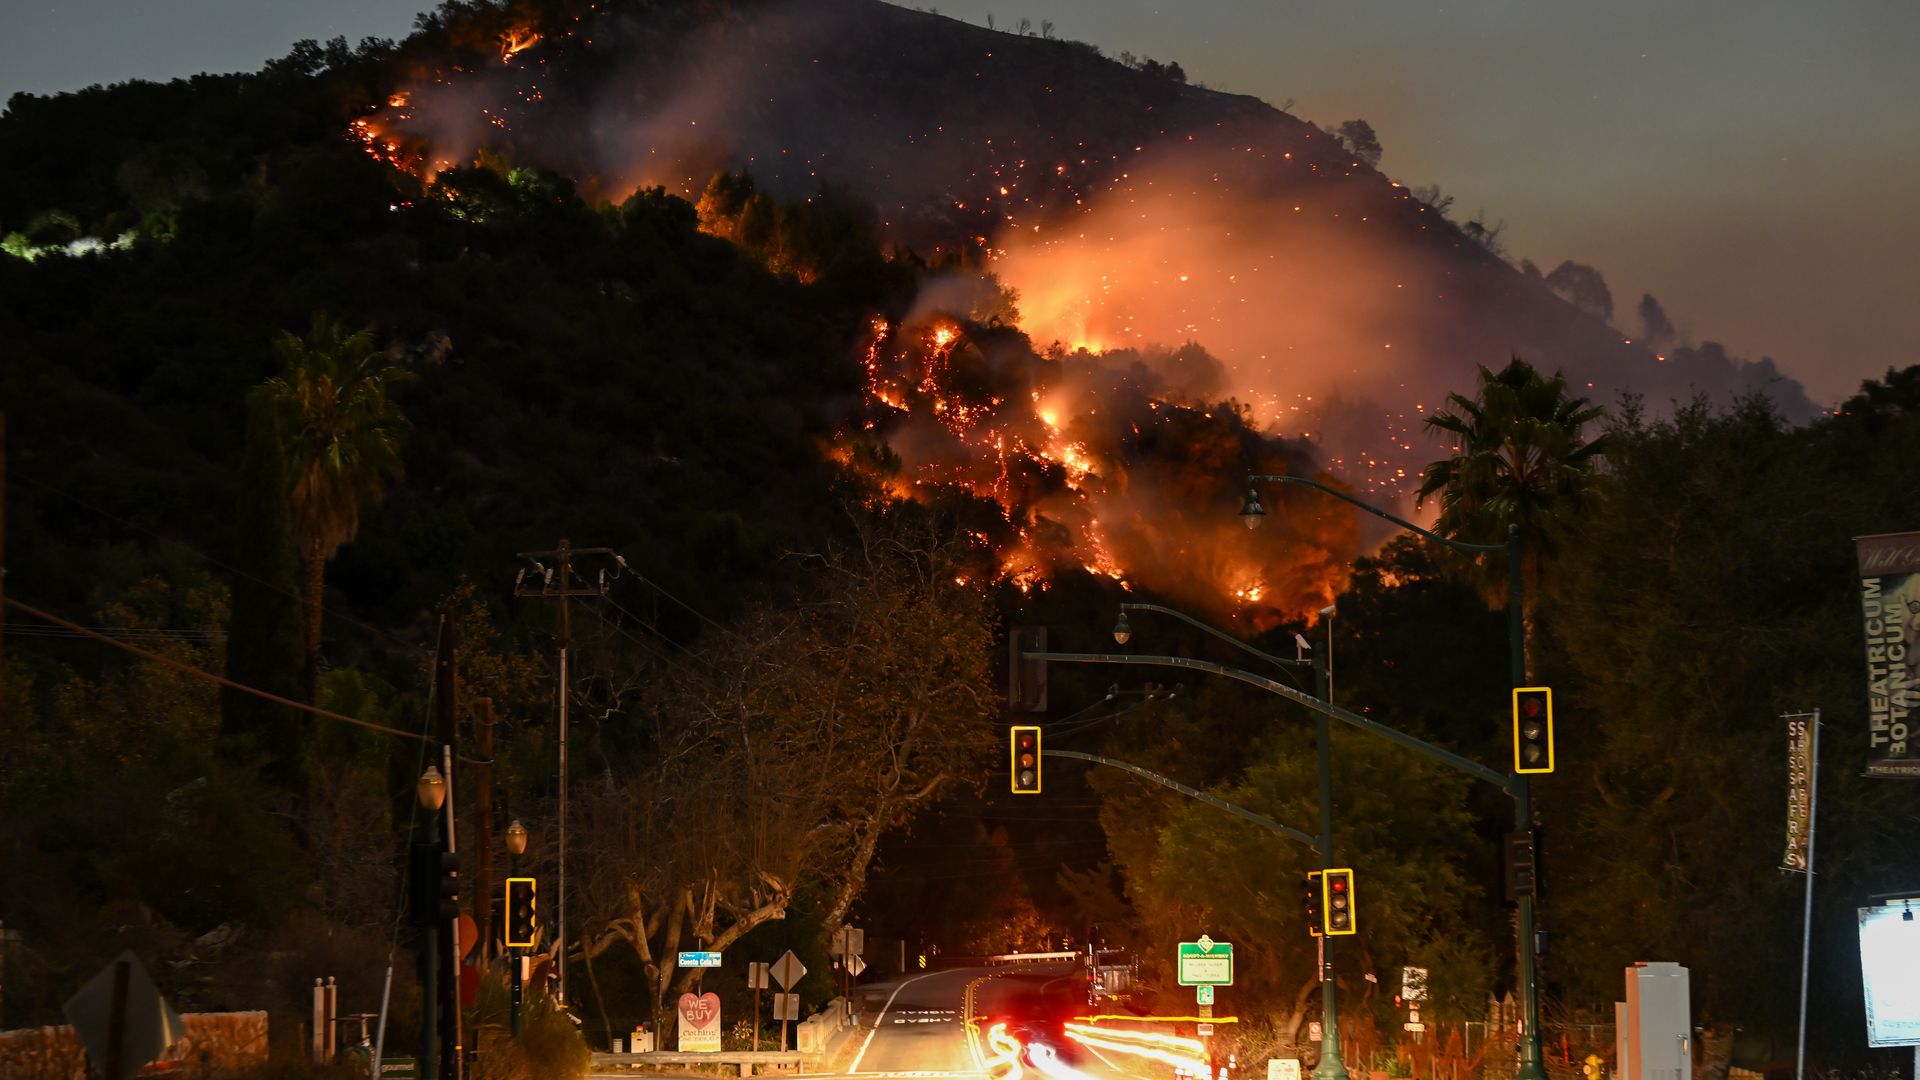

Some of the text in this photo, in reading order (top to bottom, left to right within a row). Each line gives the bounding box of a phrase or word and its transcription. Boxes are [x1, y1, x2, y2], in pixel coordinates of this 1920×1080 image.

[1861, 577, 1889, 748] THEATRICUM
[1885, 603, 1908, 757] BOTANICUM
[1785, 721, 1799, 867] SASSAFRAS
[686, 1010, 712, 1021] BUY
[688, 999, 708, 1009] WE
